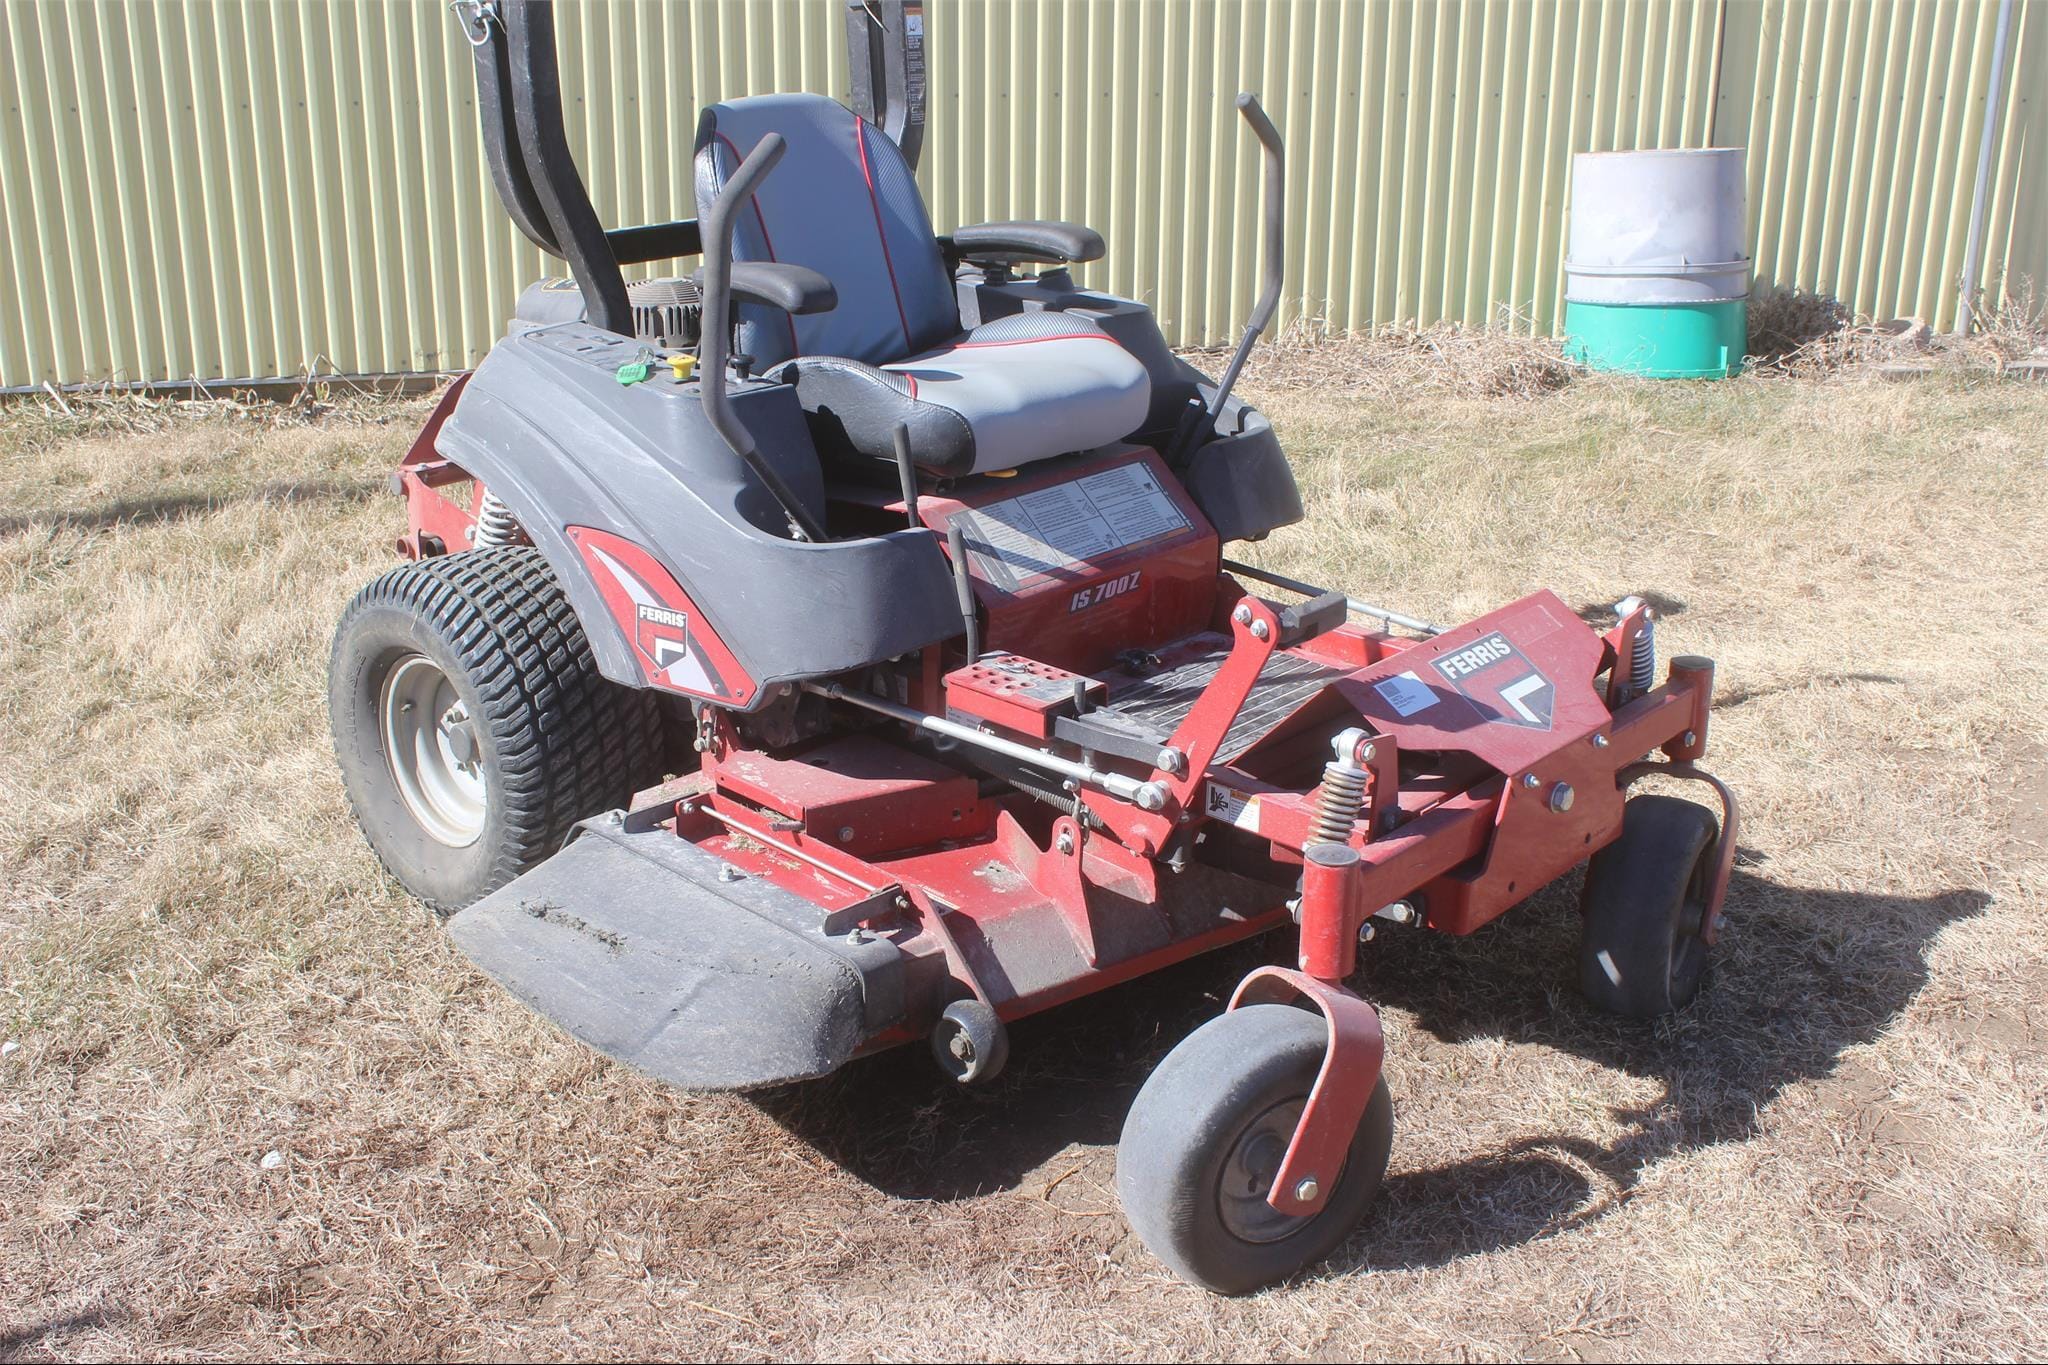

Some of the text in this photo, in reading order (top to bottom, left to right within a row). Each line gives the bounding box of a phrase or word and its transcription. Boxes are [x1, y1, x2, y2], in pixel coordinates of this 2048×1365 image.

[1071, 571, 1141, 612] IS 700Z
[639, 605, 685, 627] FERRIS
[1438, 637, 1511, 679] FERRIS
